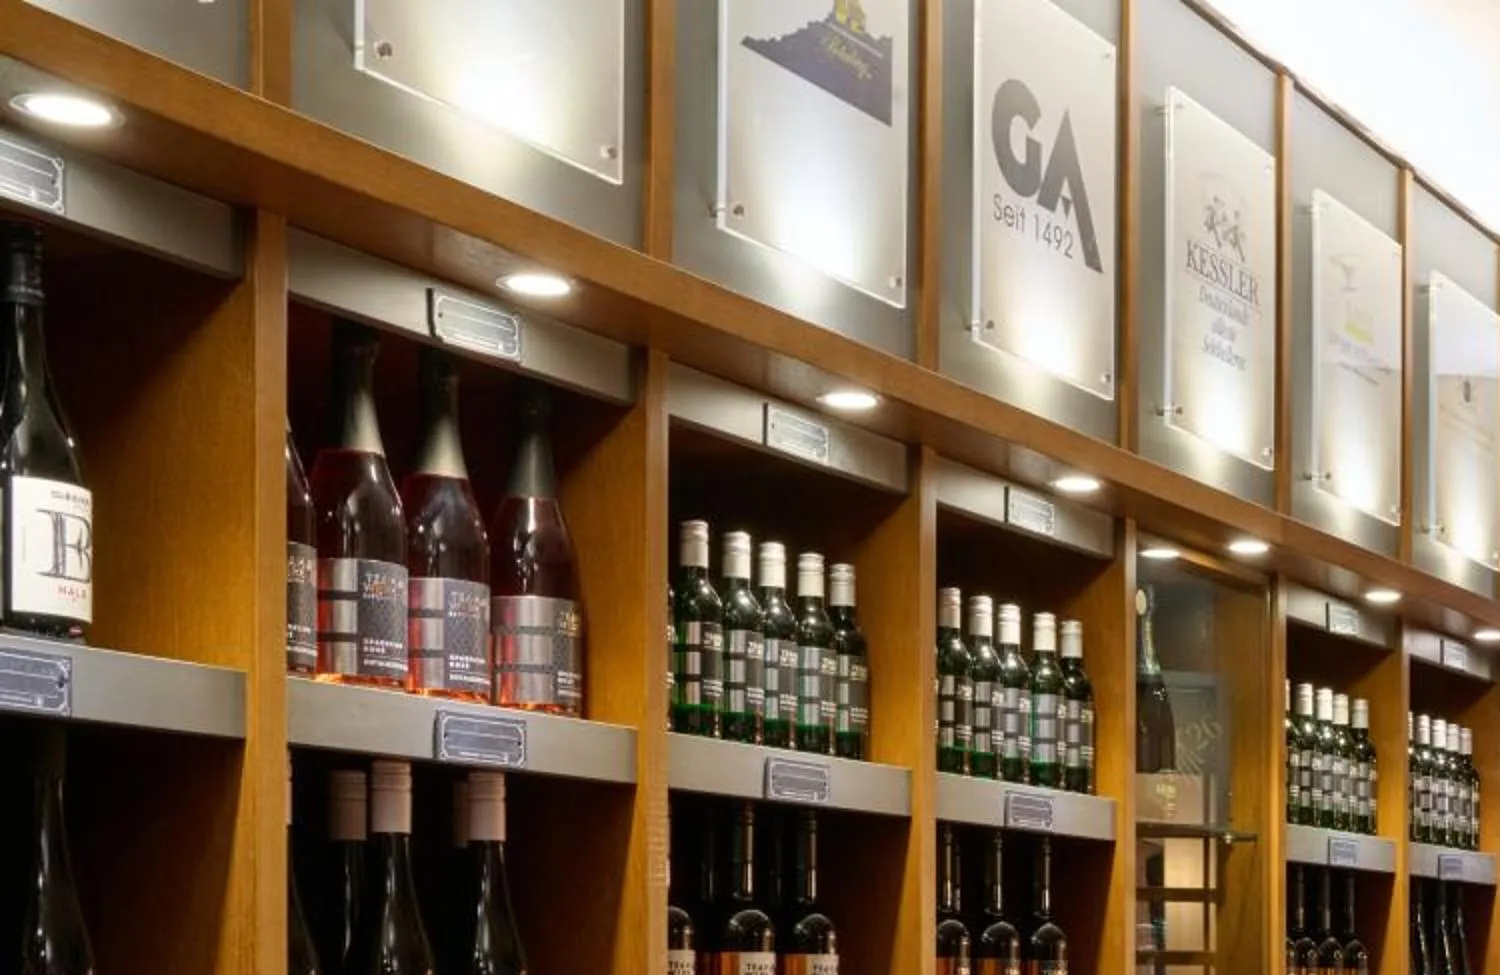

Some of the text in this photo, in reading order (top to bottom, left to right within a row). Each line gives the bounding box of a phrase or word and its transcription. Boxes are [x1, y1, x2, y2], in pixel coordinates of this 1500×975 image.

[992, 79, 1104, 273] GA
[993, 194, 1075, 260] Seit 1492
[1186, 239, 1262, 307] KESSLER
